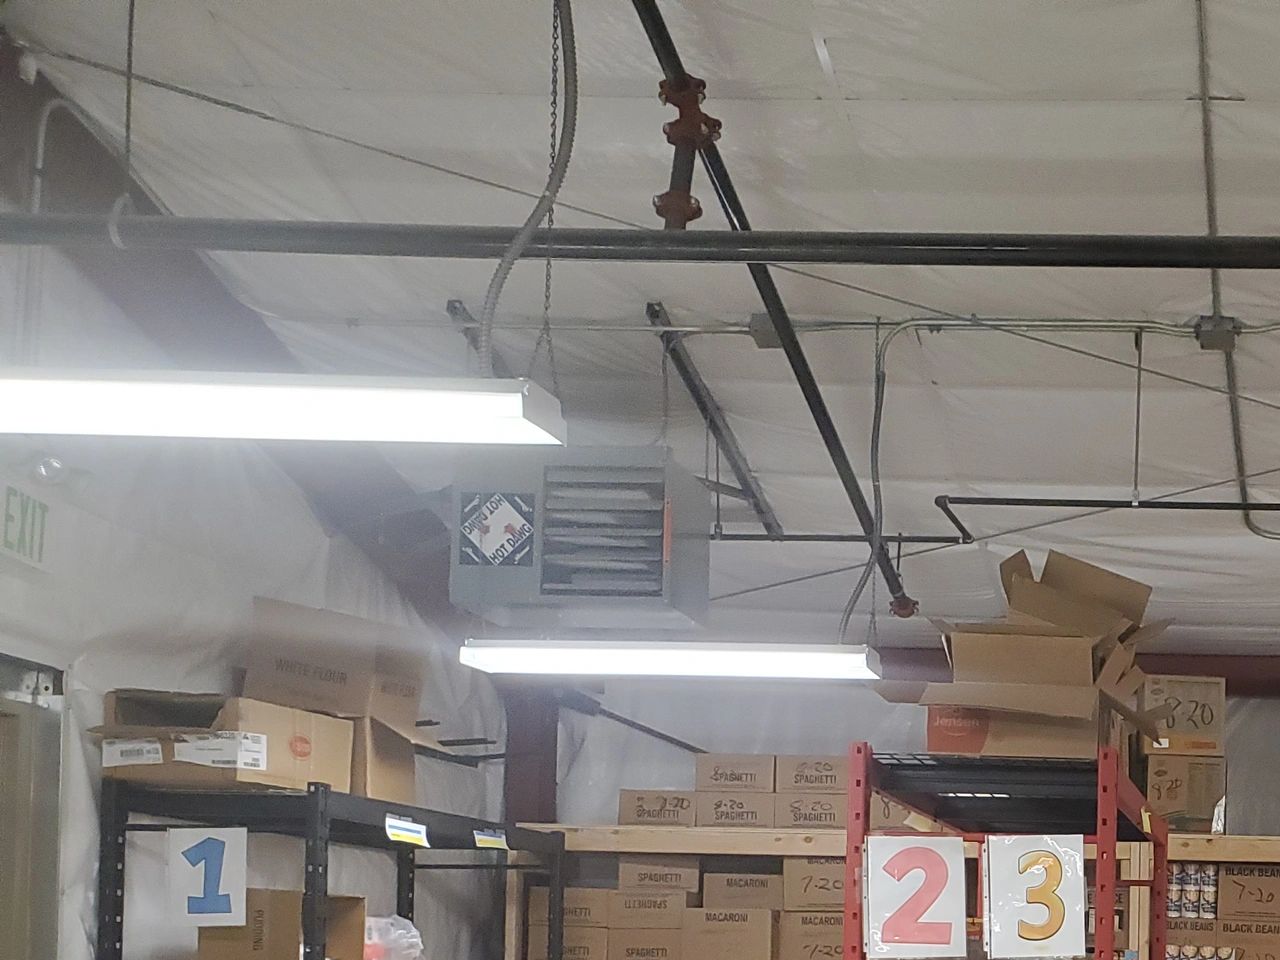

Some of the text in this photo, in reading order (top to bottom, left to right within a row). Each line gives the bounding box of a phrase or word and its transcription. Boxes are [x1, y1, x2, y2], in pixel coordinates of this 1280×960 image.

[486, 495, 506, 515] HOT
[4, 485, 50, 564] EXIT
[489, 524, 532, 564] HOT DAWG
[275, 658, 347, 686] WHITE FLOUR
[794, 773, 837, 785] SPAGHETTI
[637, 808, 679, 820] SPAGHETTI
[715, 810, 758, 821] SPAGHETTI
[793, 811, 836, 823] SPAGHETTI
[181, 837, 232, 914] 1
[638, 872, 681, 883] SPAGHETTI
[1225, 866, 1256, 878] BLACK
[726, 878, 768, 888] MACARONI
[881, 846, 952, 945] 2
[1018, 849, 1066, 941] 3
[1232, 879, 1275, 903] 7-20
[624, 899, 668, 910] SPAGHETTI
[705, 912, 748, 923] MACARONI
[252, 909, 265, 951] PUDDING
[1190, 922, 1214, 932] BEANS
[1223, 922, 1254, 933] BLACK
[626, 947, 667, 958] SPAGHETTI
